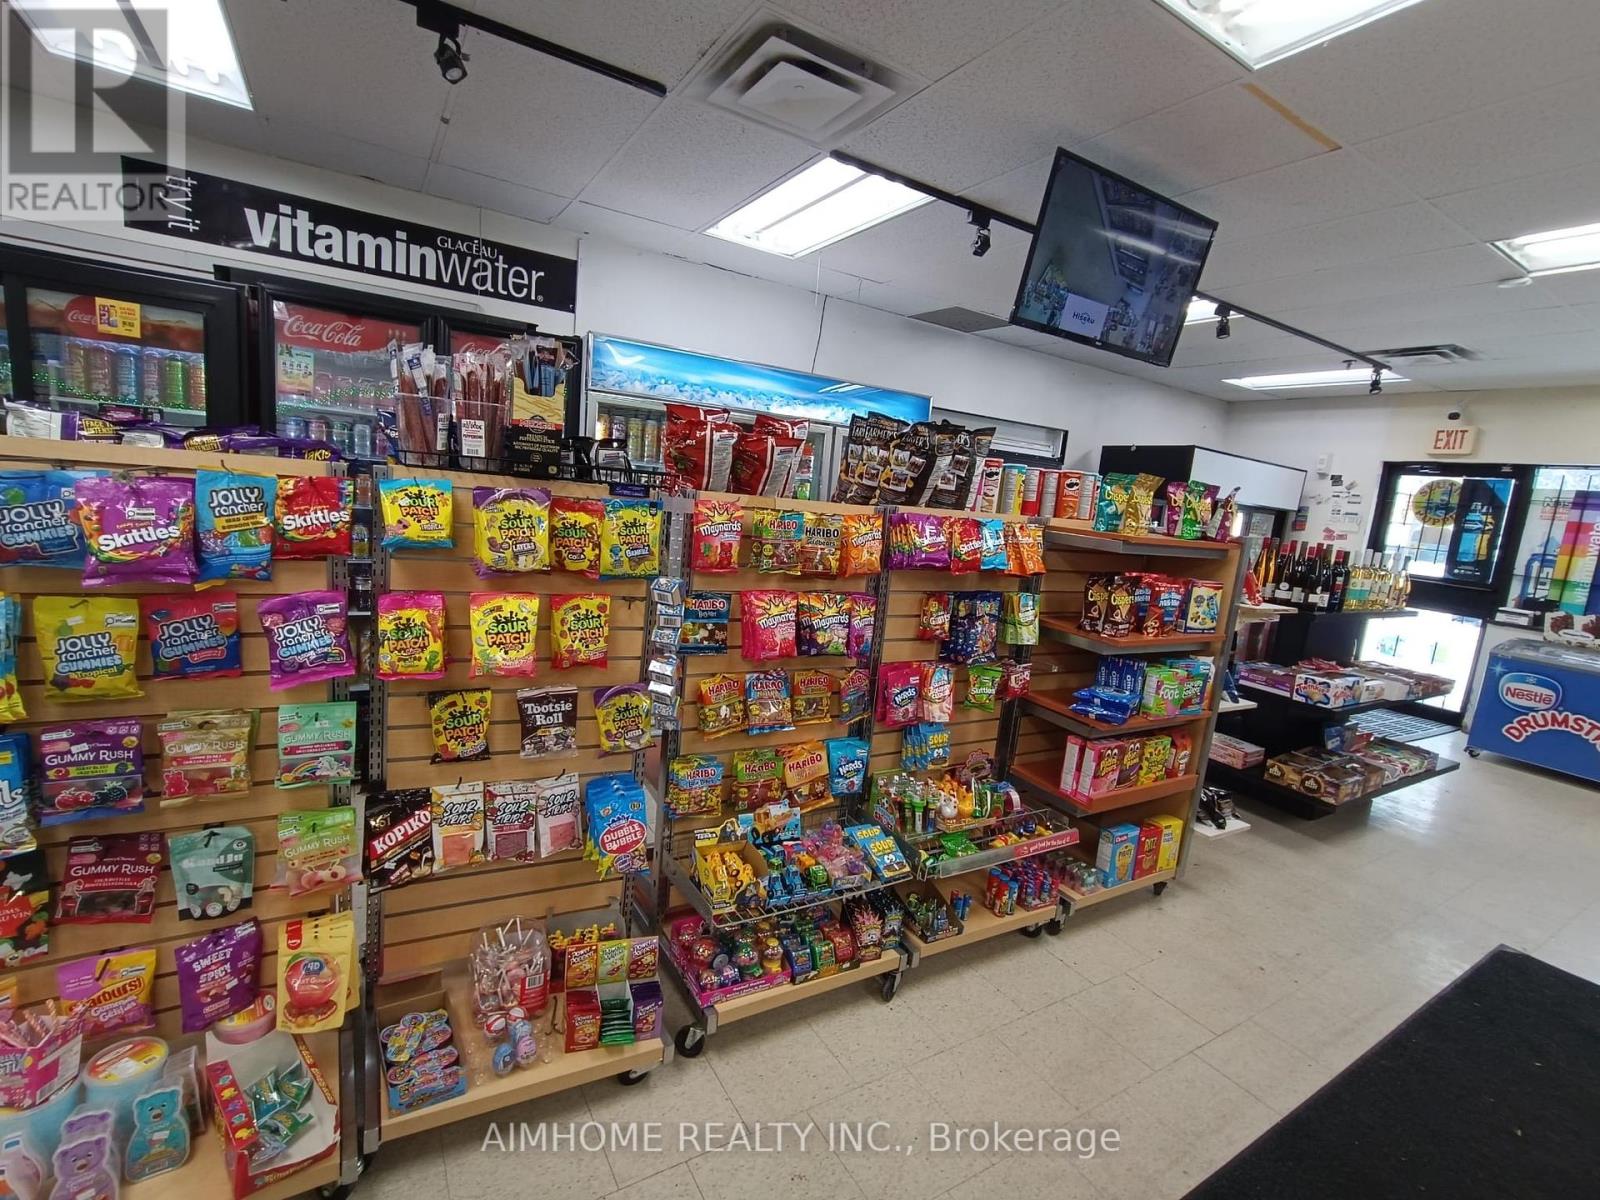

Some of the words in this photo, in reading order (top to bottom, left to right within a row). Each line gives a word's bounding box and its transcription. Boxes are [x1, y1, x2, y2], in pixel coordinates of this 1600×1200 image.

[159, 174, 198, 212] try
[167, 214, 201, 232] it
[1433, 429, 1469, 450] EXIT
[209, 488, 260, 508] JOLLY
[1, 502, 61, 525] JOLLY
[214, 502, 264, 517] rancher
[401, 506, 438, 516] PATCH
[4, 517, 67, 533] rancher
[283, 509, 350, 531] Skittles
[500, 518, 533, 528] SOUR
[700, 520, 742, 536] Maynards
[769, 519, 798, 531] HARIBO
[2, 524, 75, 545] GUMMIES
[98, 525, 181, 552] Skittles
[500, 527, 535, 538] PATCH
[557, 527, 588, 538] SOUR
[619, 525, 646, 536] SOUR
[805, 527, 840, 539] HARIBO
[555, 537, 590, 547] PATCH
[619, 534, 649, 545] PATCH
[160, 616, 212, 638] JOLLY
[276, 617, 322, 641] JOLLY
[488, 620, 528, 633] SOUR
[570, 619, 602, 630] SOUR
[813, 613, 849, 630] Maynards
[166, 628, 218, 647] rancher
[282, 630, 329, 648] rancher
[390, 626, 426, 640] SOUR
[488, 632, 530, 645] PATCH
[571, 628, 604, 640] PATCH
[57, 633, 110, 654] JOLLY
[162, 636, 226, 659] GUMMIES
[279, 636, 333, 659] GUMMIES
[389, 637, 429, 651] PATCH
[61, 645, 116, 661] rancher
[56, 654, 122, 673] GUMMIES
[77, 666, 118, 679] Tropical
[708, 680, 740, 696] HARIBO
[523, 701, 573, 716] Tootsie
[613, 708, 640, 721] SOUR
[444, 713, 482, 729] SOUR
[535, 713, 564, 726] Roll
[614, 717, 642, 730] PATCH
[283, 732, 320, 744] GUMMY
[322, 730, 350, 740] RUSH
[444, 725, 485, 741] PATCH
[929, 734, 949, 746] SOUR
[45, 751, 96, 766] GUMMY
[99, 749, 134, 761] RUSH
[788, 753, 822, 773] HARIBO
[686, 769, 717, 780] HARIBO
[837, 760, 863, 777] Nerds
[546, 790, 578, 807] SOUR
[443, 799, 478, 817] SOUR
[497, 800, 531, 817] SOUR
[545, 802, 574, 818] STRIPS
[438, 812, 474, 827] STRIPS
[493, 812, 525, 826] STRIPS
[603, 823, 641, 843] DUBBLE
[284, 843, 320, 858] GUMMY
[323, 834, 350, 847] RUSH
[605, 831, 643, 852] BUBBLE
[70, 864, 119, 877] GUMMY
[121, 863, 154, 875] RUSH
[193, 948, 233, 972] SWEET
[307, 961, 320, 970] 4D
[199, 964, 231, 984] SPICY
